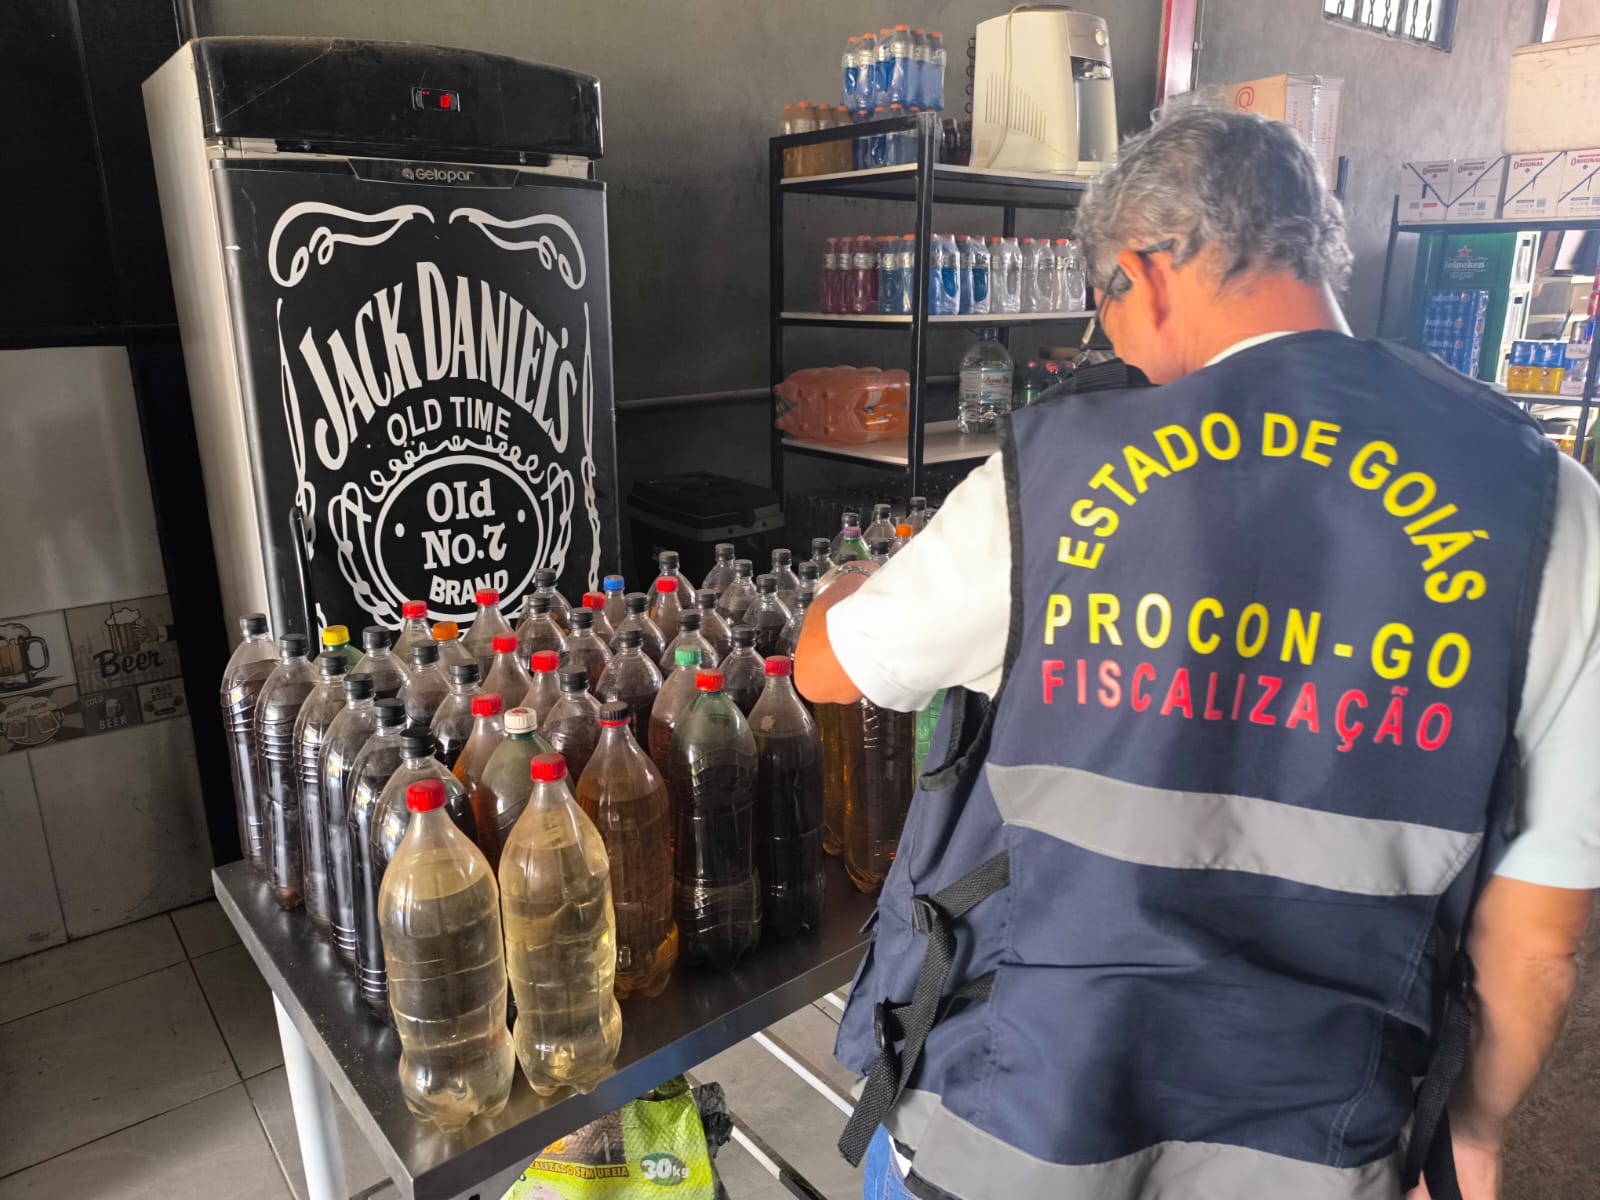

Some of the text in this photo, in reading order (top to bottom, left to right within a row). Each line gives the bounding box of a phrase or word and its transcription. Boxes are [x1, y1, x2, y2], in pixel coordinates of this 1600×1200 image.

[415, 168, 475, 183] Gelopar
[299, 261, 578, 471] JACK DANIEL'S
[387, 396, 512, 446] OLD TIME
[426, 478, 496, 523] Old
[1057, 412, 1490, 603] ESTADO DE GOIÁS
[421, 522, 507, 570] No.7
[429, 569, 509, 606] BRAND
[93, 650, 163, 678] Beer
[99, 716, 127, 729] BEER
[1042, 659, 1453, 752] FISCALIZAÇÃO
[530, 1161, 630, 1179] ALIZADO SEM UREIA
